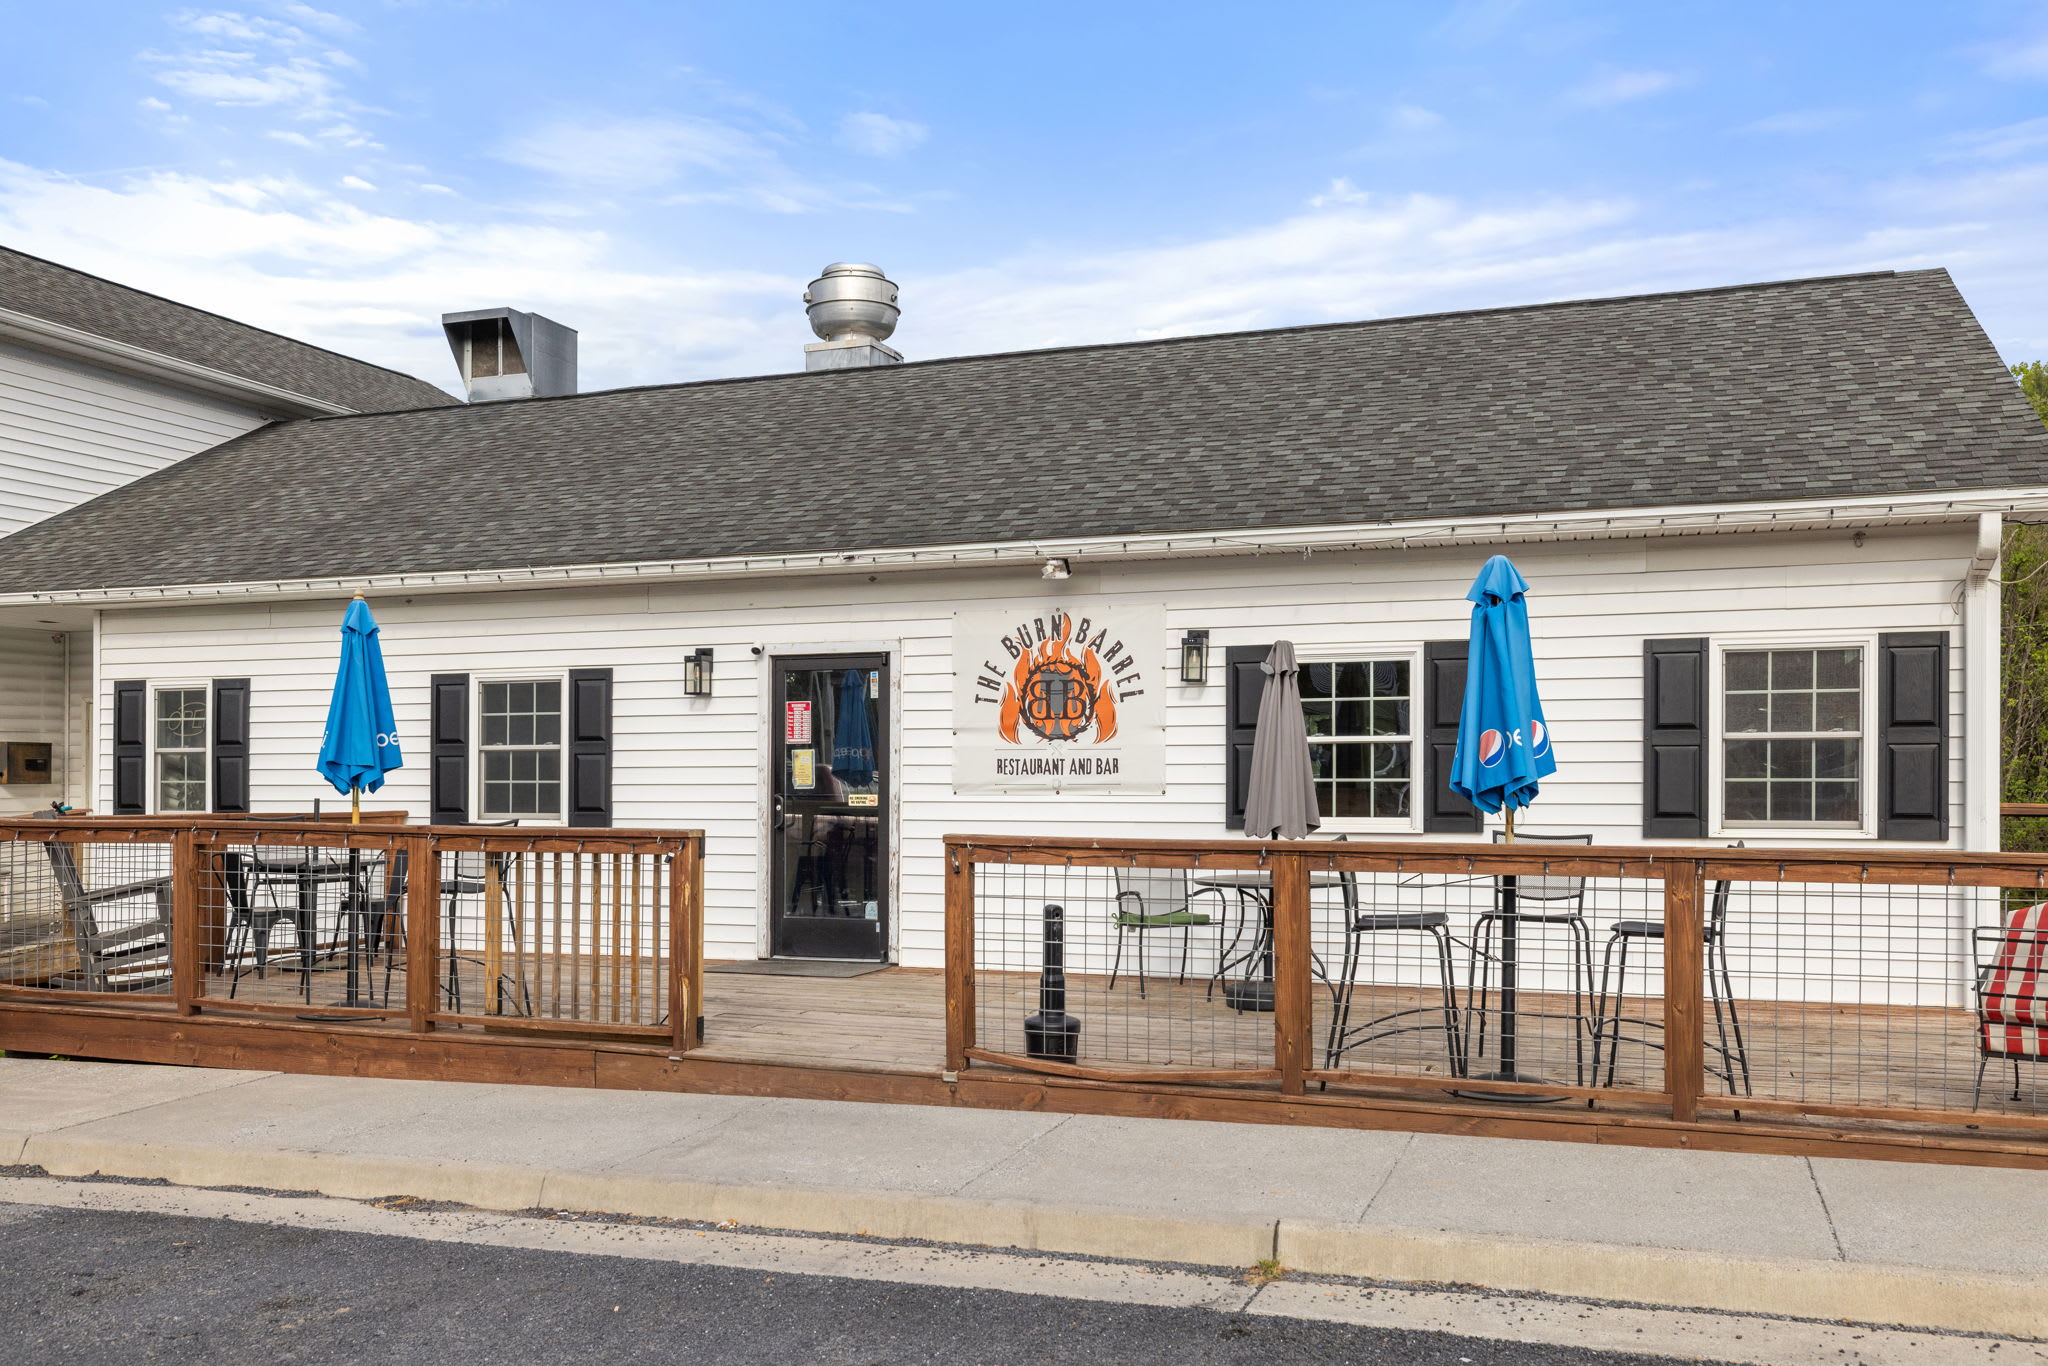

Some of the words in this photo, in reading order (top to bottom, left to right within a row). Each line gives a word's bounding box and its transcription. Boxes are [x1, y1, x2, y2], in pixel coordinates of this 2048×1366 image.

[975, 660, 1007, 704] THE
[1001, 614, 1062, 660] BURN
[1075, 617, 1145, 703] BARREL
[997, 758, 1066, 776] RESTAURANT
[1069, 758, 1092, 776] AND
[1096, 758, 1119, 775] BAR
